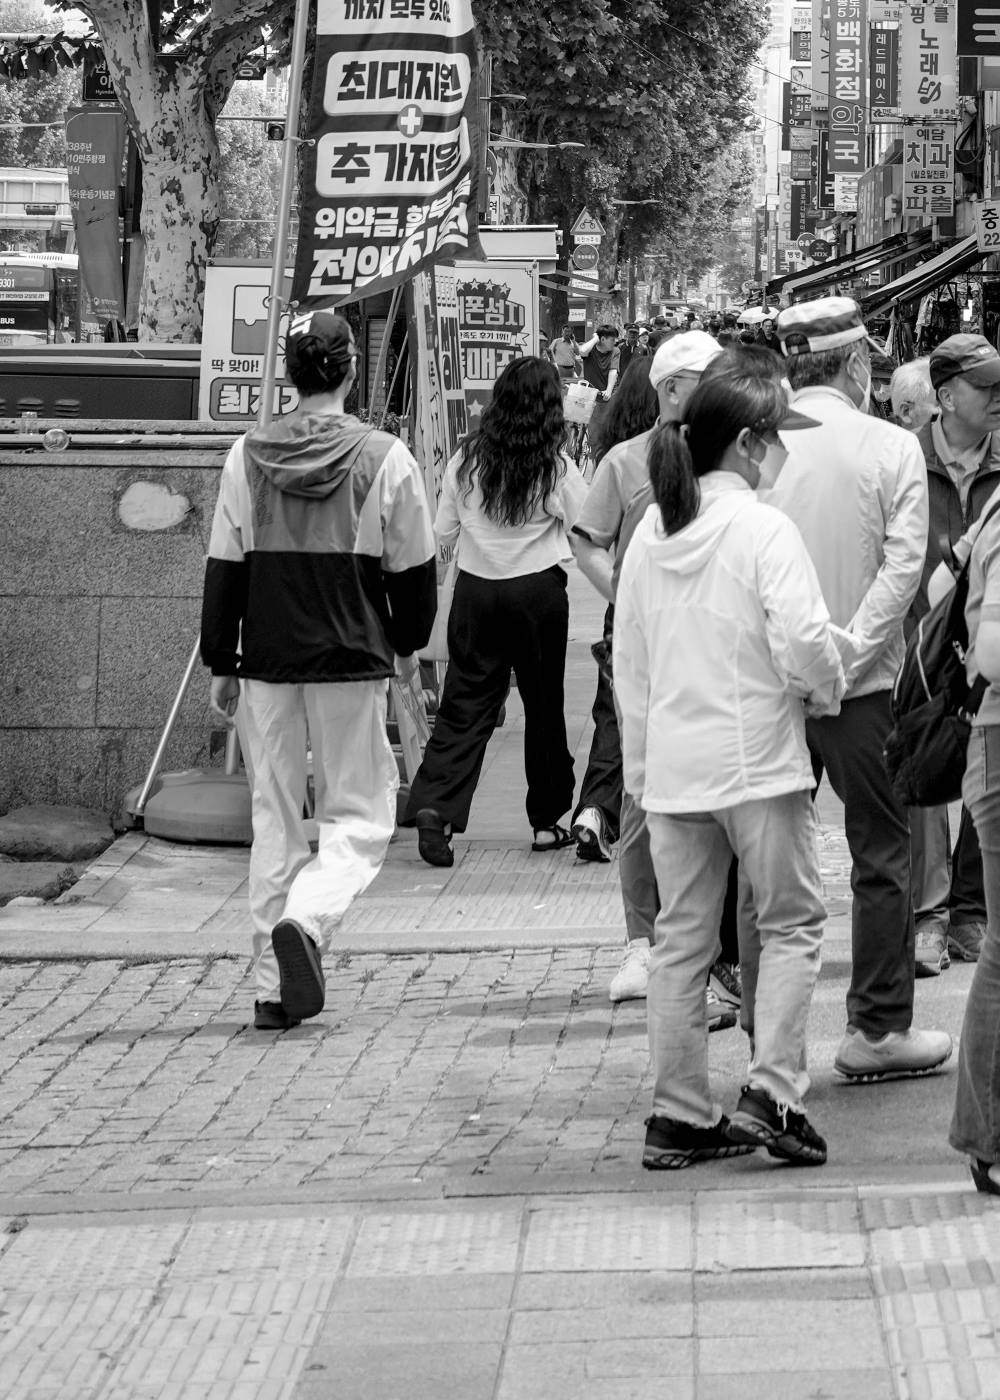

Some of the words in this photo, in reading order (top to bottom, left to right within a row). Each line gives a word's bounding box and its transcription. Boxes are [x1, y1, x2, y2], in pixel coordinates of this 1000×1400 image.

[834, 21, 863, 100] 백화점
[875, 33, 887, 106] 레드페이스
[337, 59, 463, 104] 최대지원
[831, 104, 864, 165] 약국
[916, 128, 946, 141] 예담
[330, 141, 461, 185] 추가지원
[906, 142, 952, 169] 치과
[906, 195, 952, 214] 파출
[912, 184, 947, 195] 88
[211, 359, 225, 373] 딱
[228, 359, 260, 373] 맞아!
